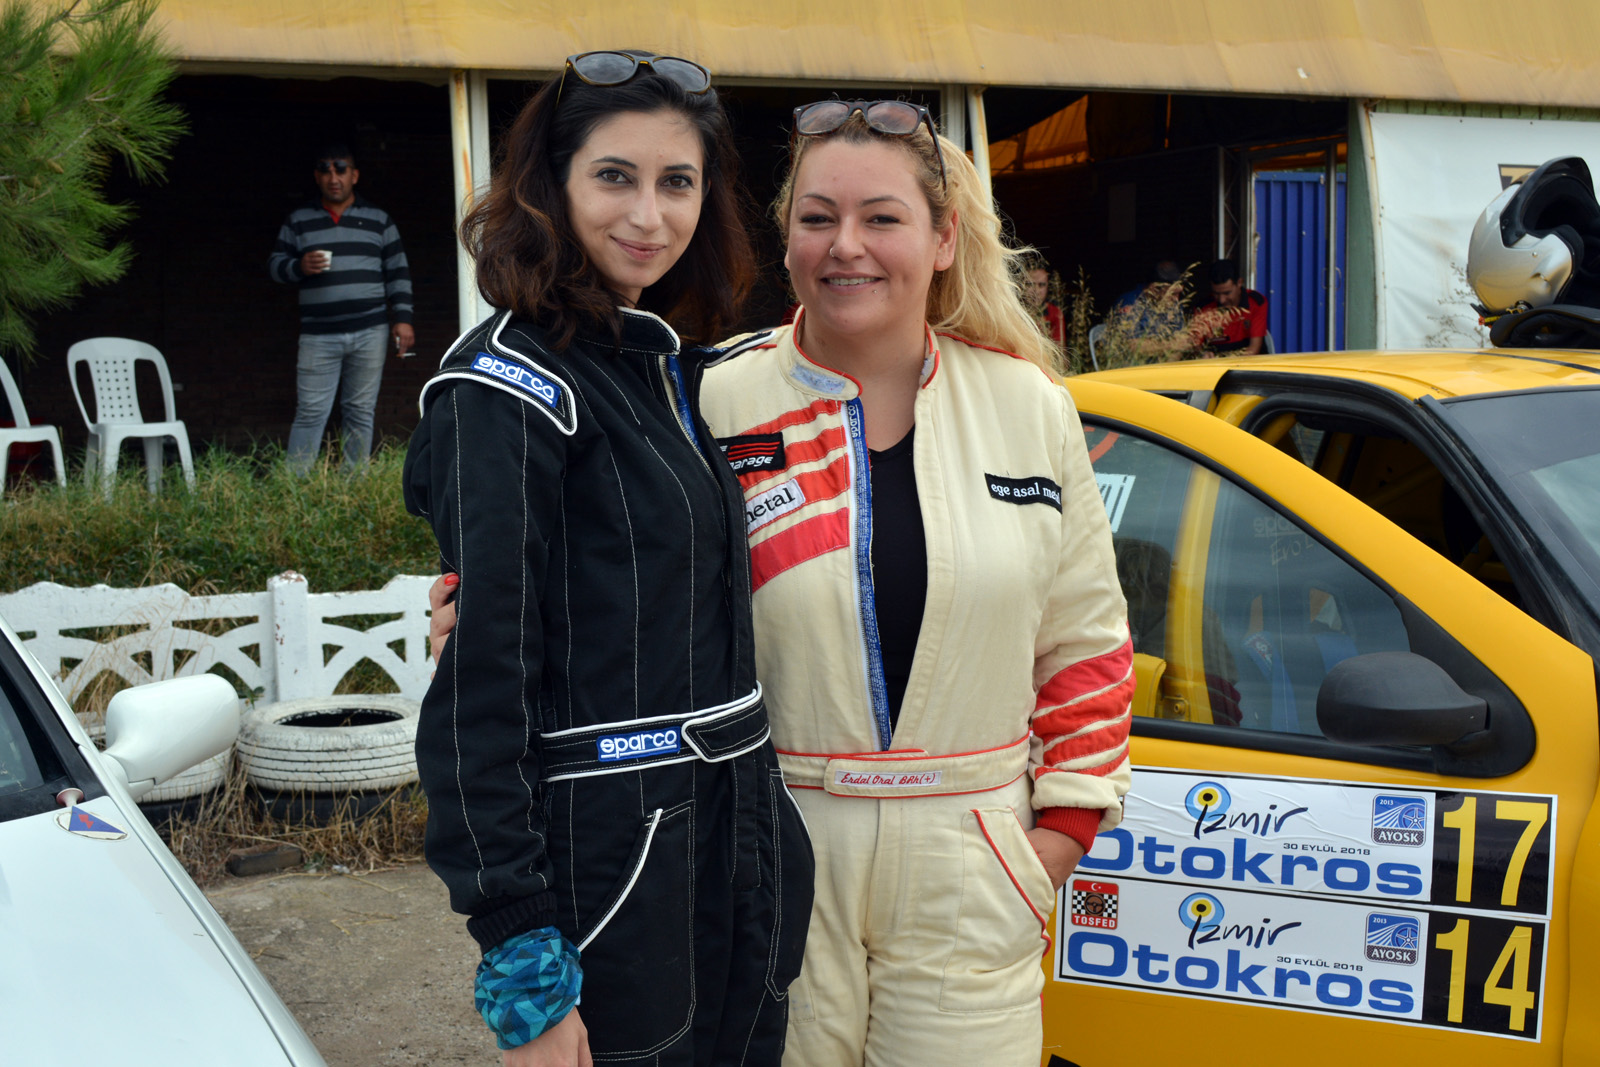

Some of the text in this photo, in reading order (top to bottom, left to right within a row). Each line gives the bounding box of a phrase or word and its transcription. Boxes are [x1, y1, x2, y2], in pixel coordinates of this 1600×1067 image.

[475, 356, 555, 403] sparco
[848, 405, 861, 437] sparco
[991, 483, 1010, 496] ege
[1013, 482, 1040, 497] asal
[600, 730, 677, 758] sparco
[840, 773, 871, 784] Erdal
[872, 773, 895, 785] Oral
[1378, 830, 1419, 844] AYOSK
[1283, 842, 1371, 856] 30 EYLÜL 2018
[1443, 796, 1548, 907] 17
[1078, 828, 1423, 896] Otokros
[1074, 914, 1117, 928] TOSFED
[1276, 955, 1363, 972] 30 EYLÜL 2018
[1371, 947, 1412, 963] AYOSK
[1067, 931, 1415, 1013] Otokros
[1435, 919, 1534, 1032] 14
